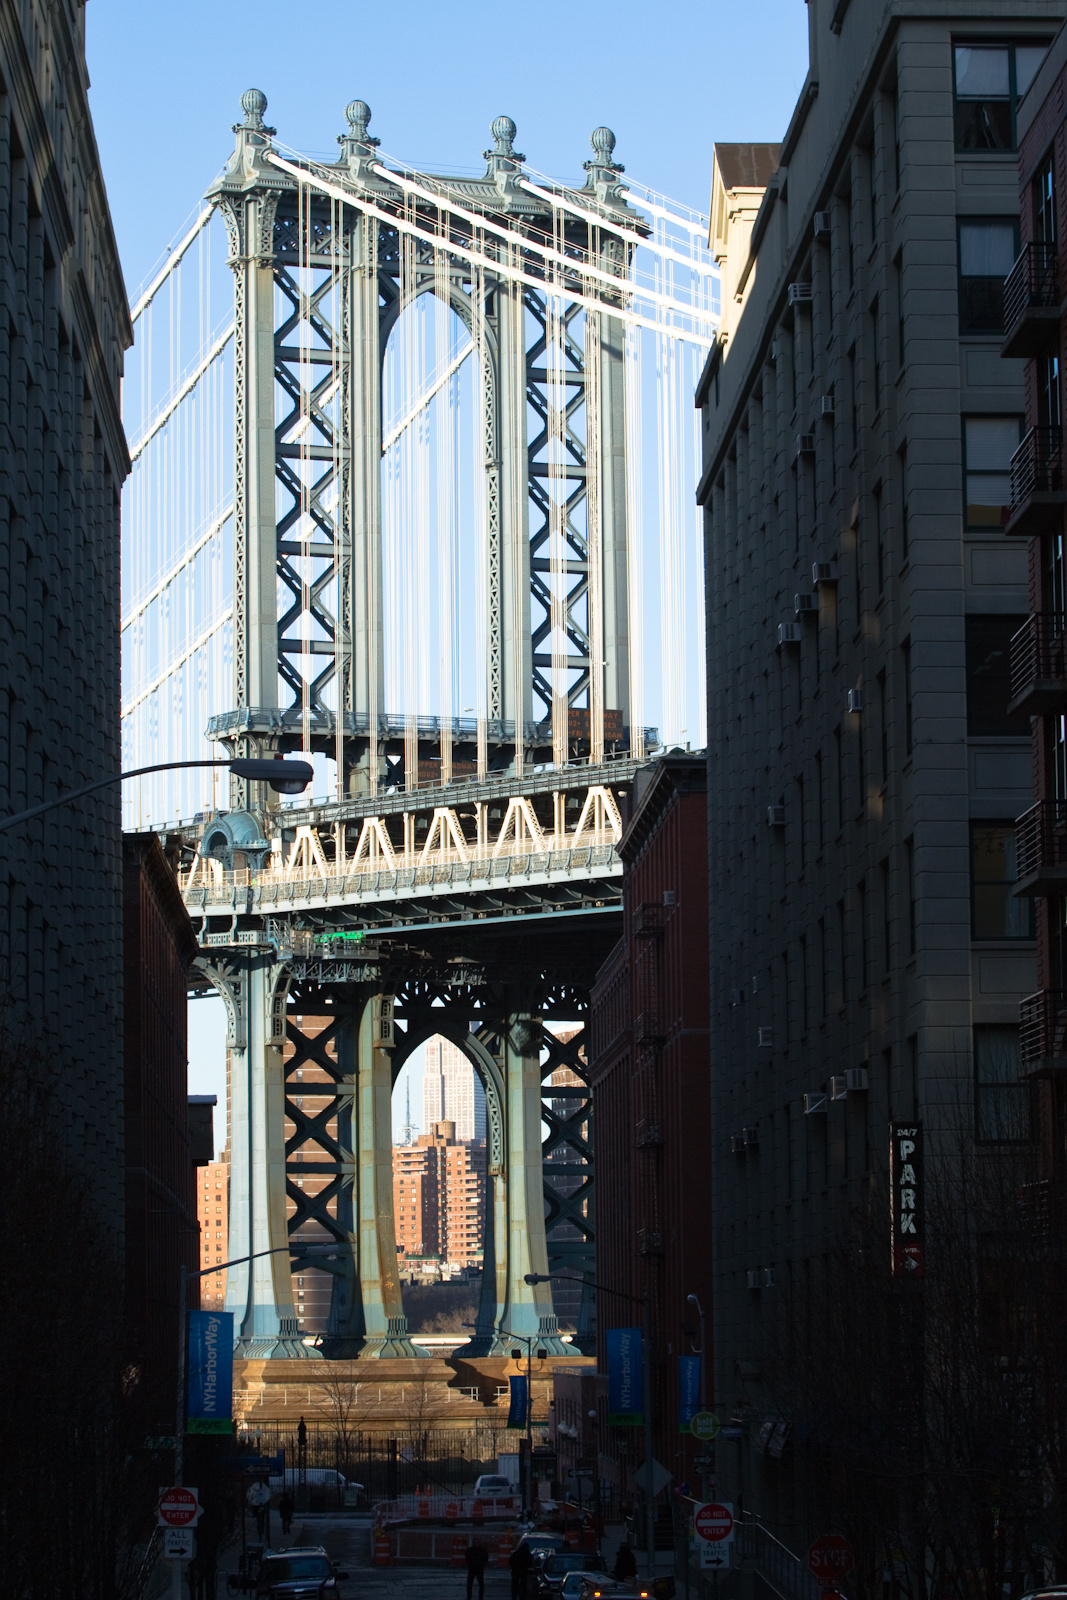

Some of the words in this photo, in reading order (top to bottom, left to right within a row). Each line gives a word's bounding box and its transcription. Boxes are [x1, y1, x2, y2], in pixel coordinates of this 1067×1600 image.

[897, 1128, 918, 1138] 24/7
[899, 1140, 918, 1234] PARK
[203, 1316, 222, 1412] NYHarborWay
[620, 1333, 632, 1408] NYHarborWay
[696, 1417, 713, 1426] half
[697, 1426, 714, 1434] pint
[811, 1549, 849, 1567] STOP
